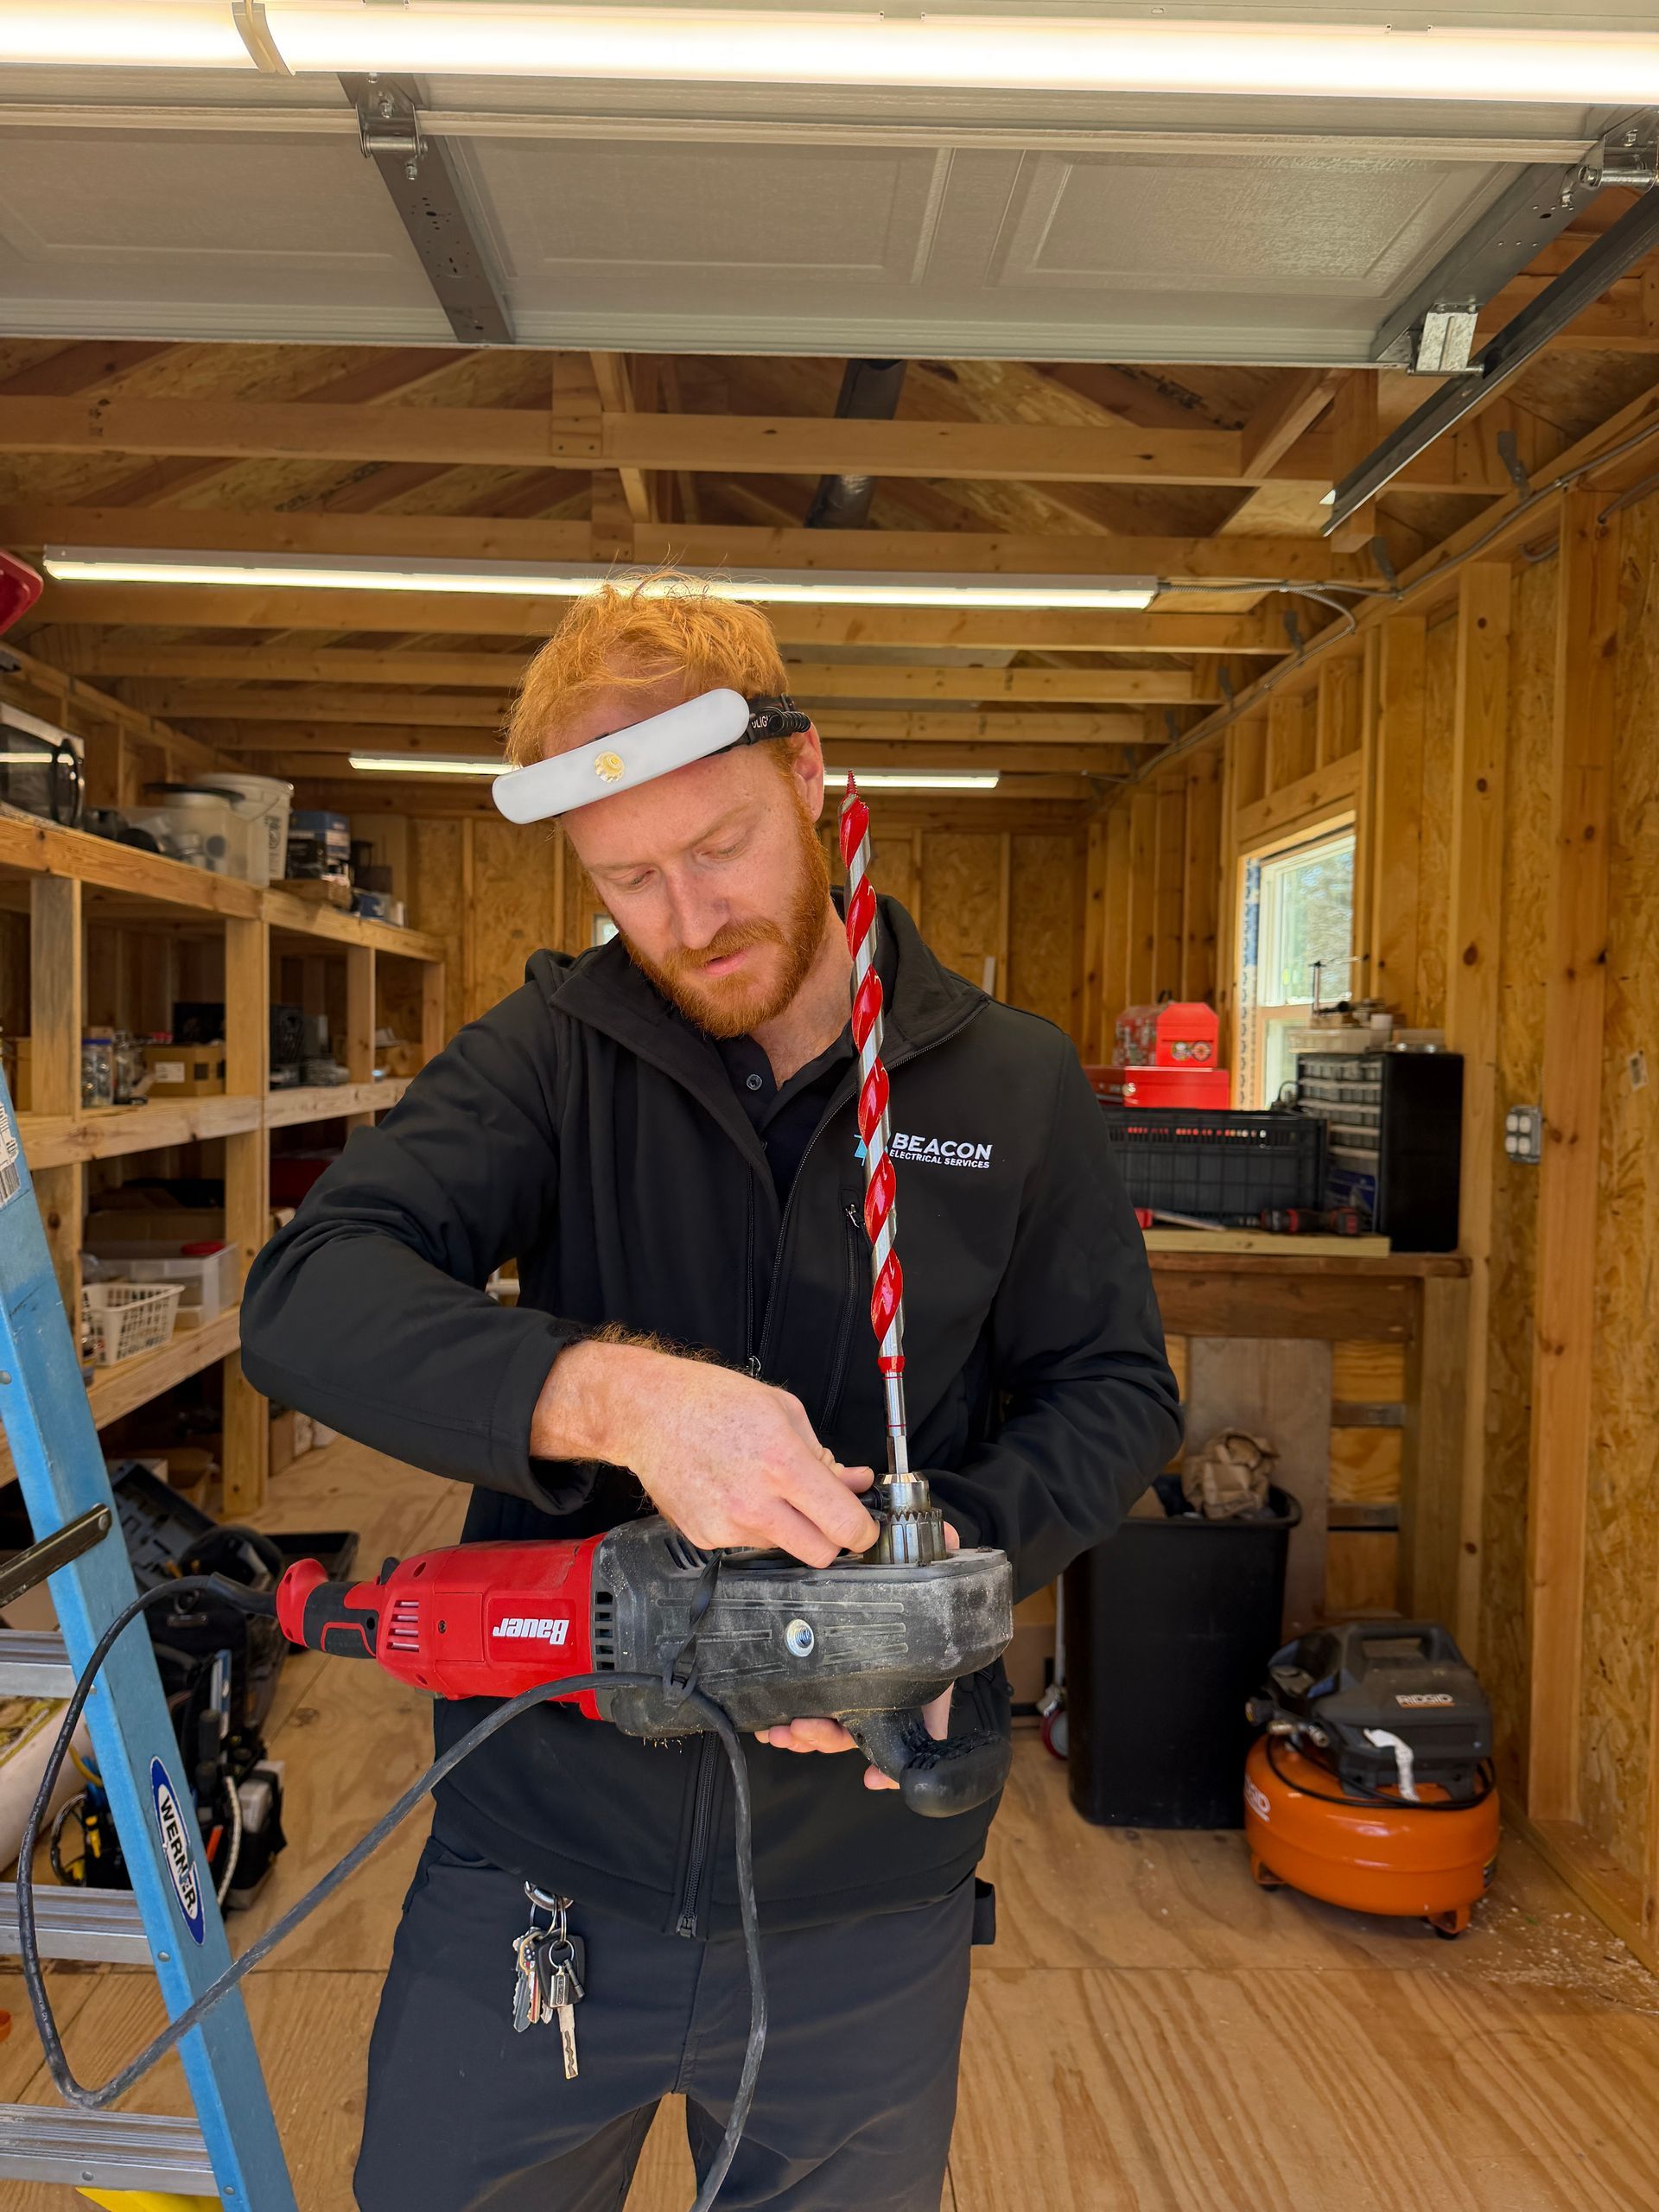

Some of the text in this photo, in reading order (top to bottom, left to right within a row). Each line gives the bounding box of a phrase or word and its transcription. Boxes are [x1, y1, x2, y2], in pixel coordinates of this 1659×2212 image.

[892, 1132, 993, 1160] BEACON
[889, 1149, 990, 1168] ELECTRICAL SERVICES
[492, 1618, 569, 1645] Bauer
[1395, 1694, 1453, 1706] RIDGID
